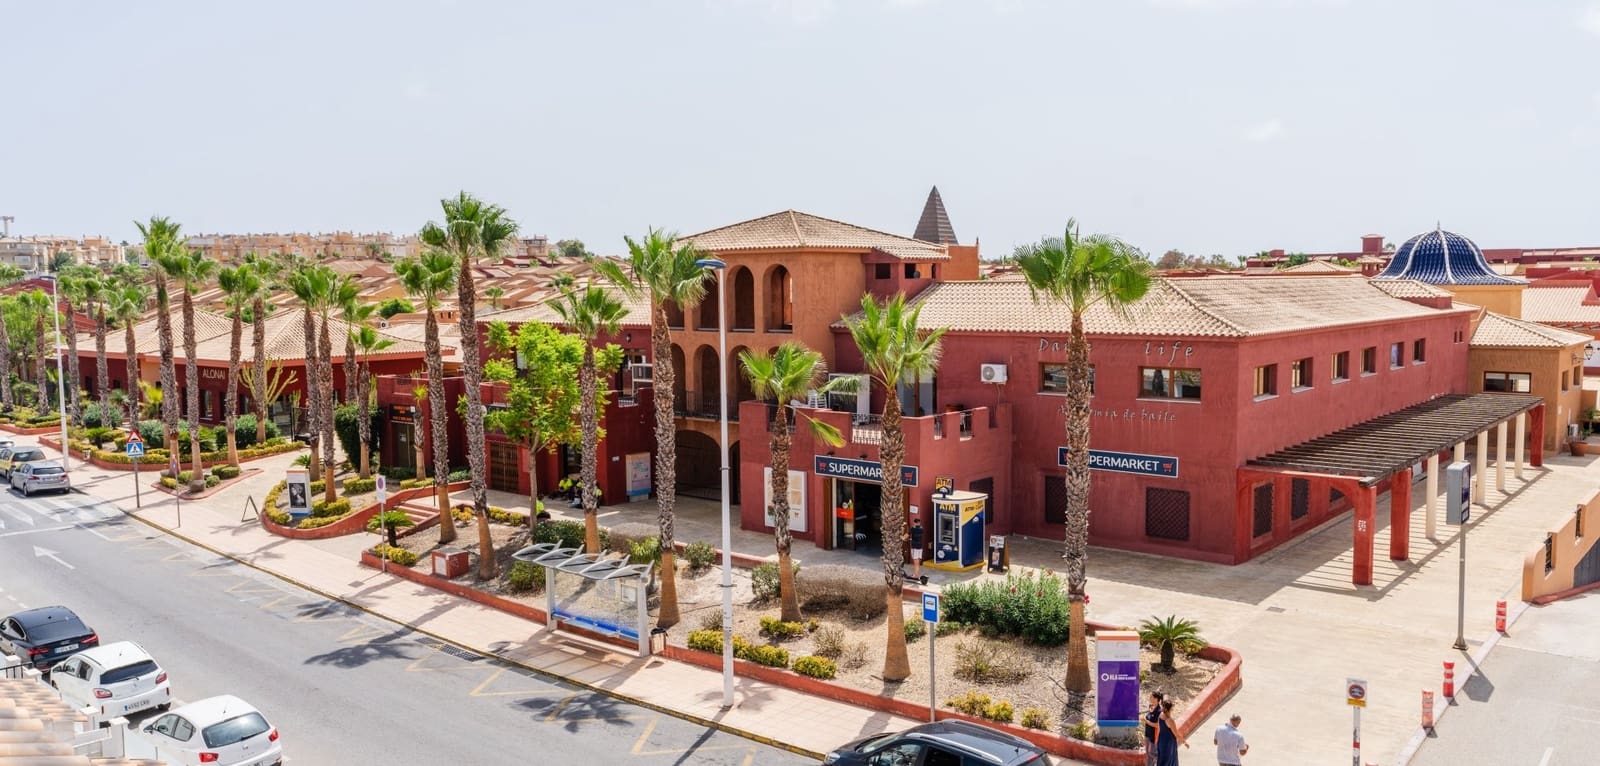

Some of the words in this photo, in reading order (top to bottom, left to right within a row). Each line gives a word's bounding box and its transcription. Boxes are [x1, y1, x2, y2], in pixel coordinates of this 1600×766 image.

[1145, 340, 1193, 366] life
[828, 462, 882, 478] SUPERMAR
[1088, 455, 1160, 471] PERMARKET
[936, 478, 952, 486] ATM
[940, 503, 956, 512] ATM
